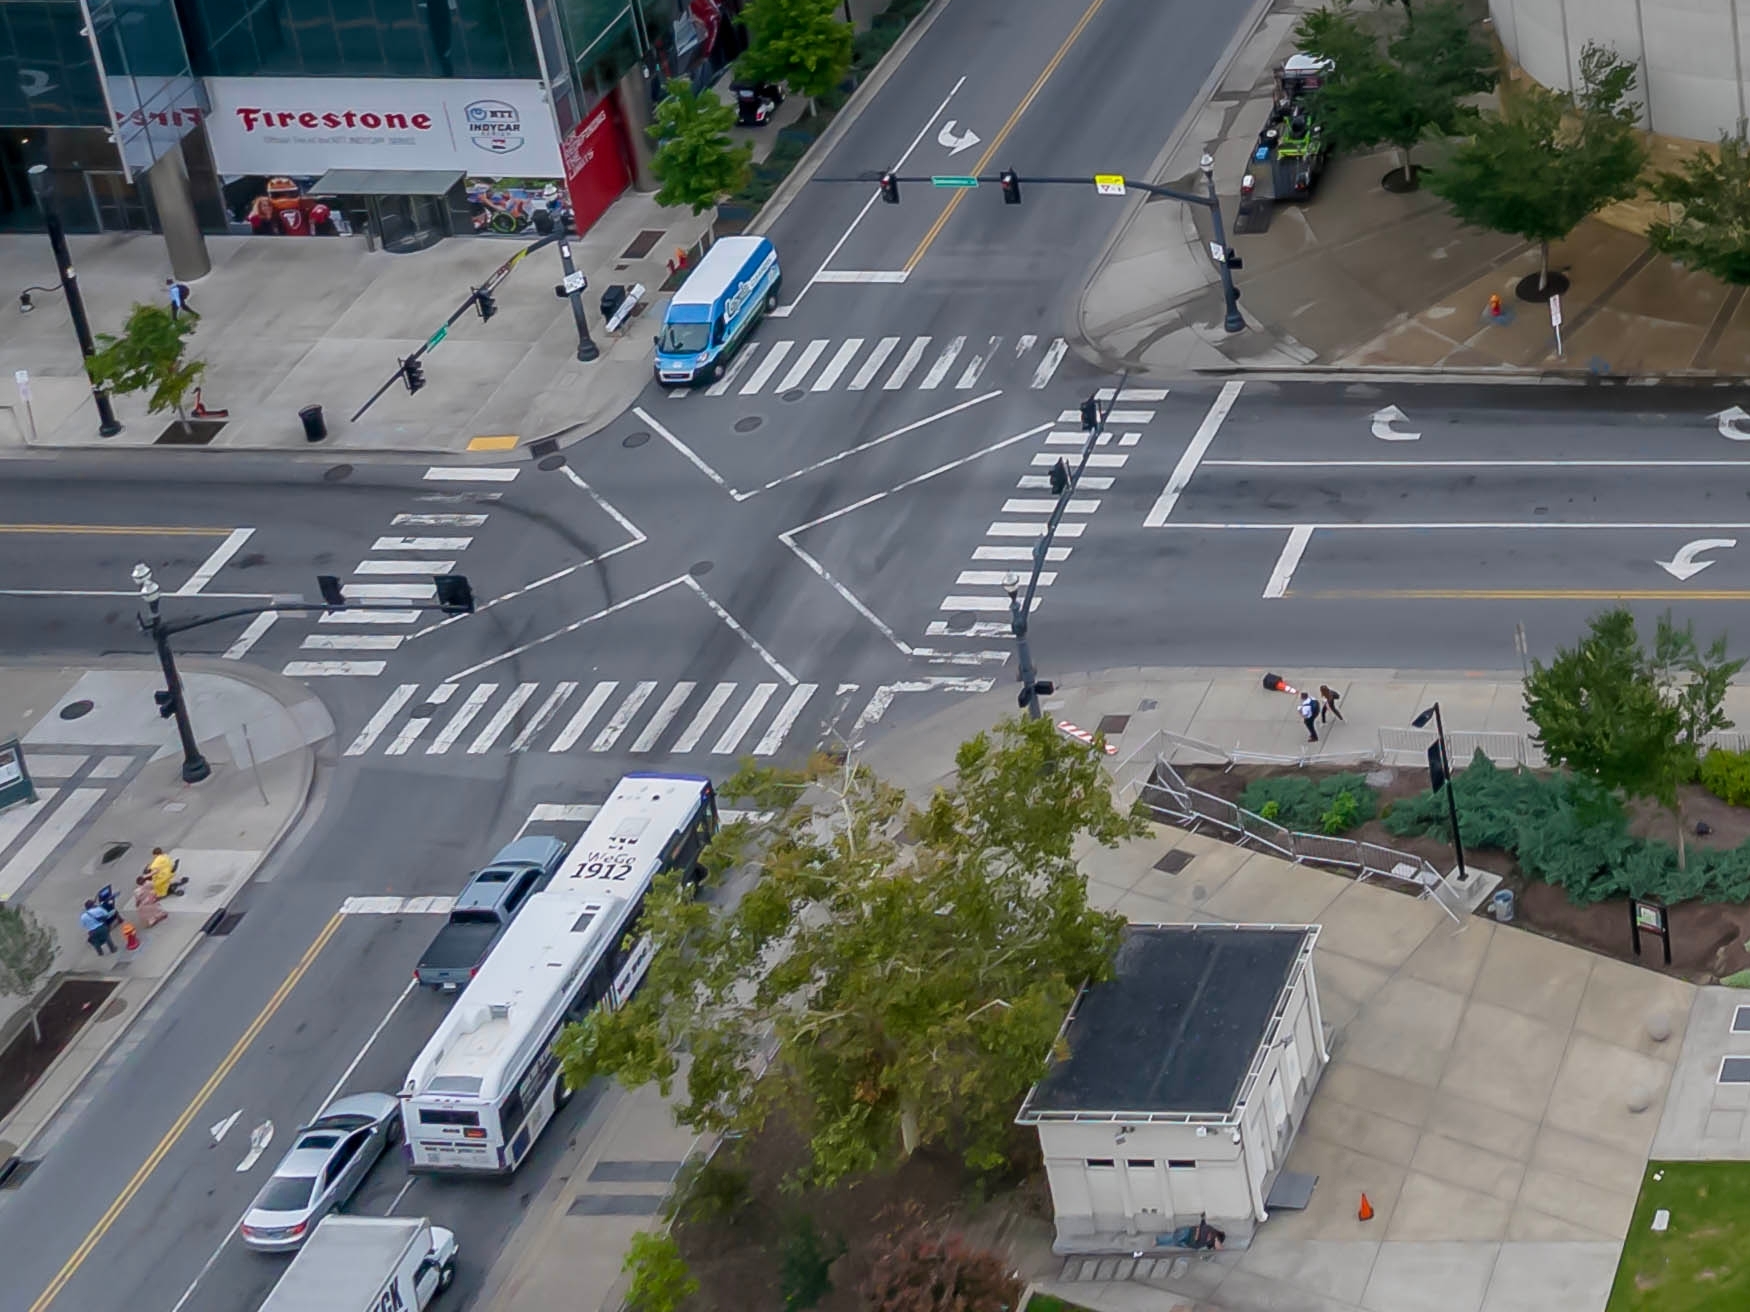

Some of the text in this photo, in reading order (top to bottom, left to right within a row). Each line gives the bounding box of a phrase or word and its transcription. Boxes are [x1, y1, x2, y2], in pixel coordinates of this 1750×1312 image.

[236, 108, 432, 132] Firestone
[469, 123, 521, 132] INDYCAR
[588, 851, 636, 865] WeGo
[570, 863, 632, 881] 1912
